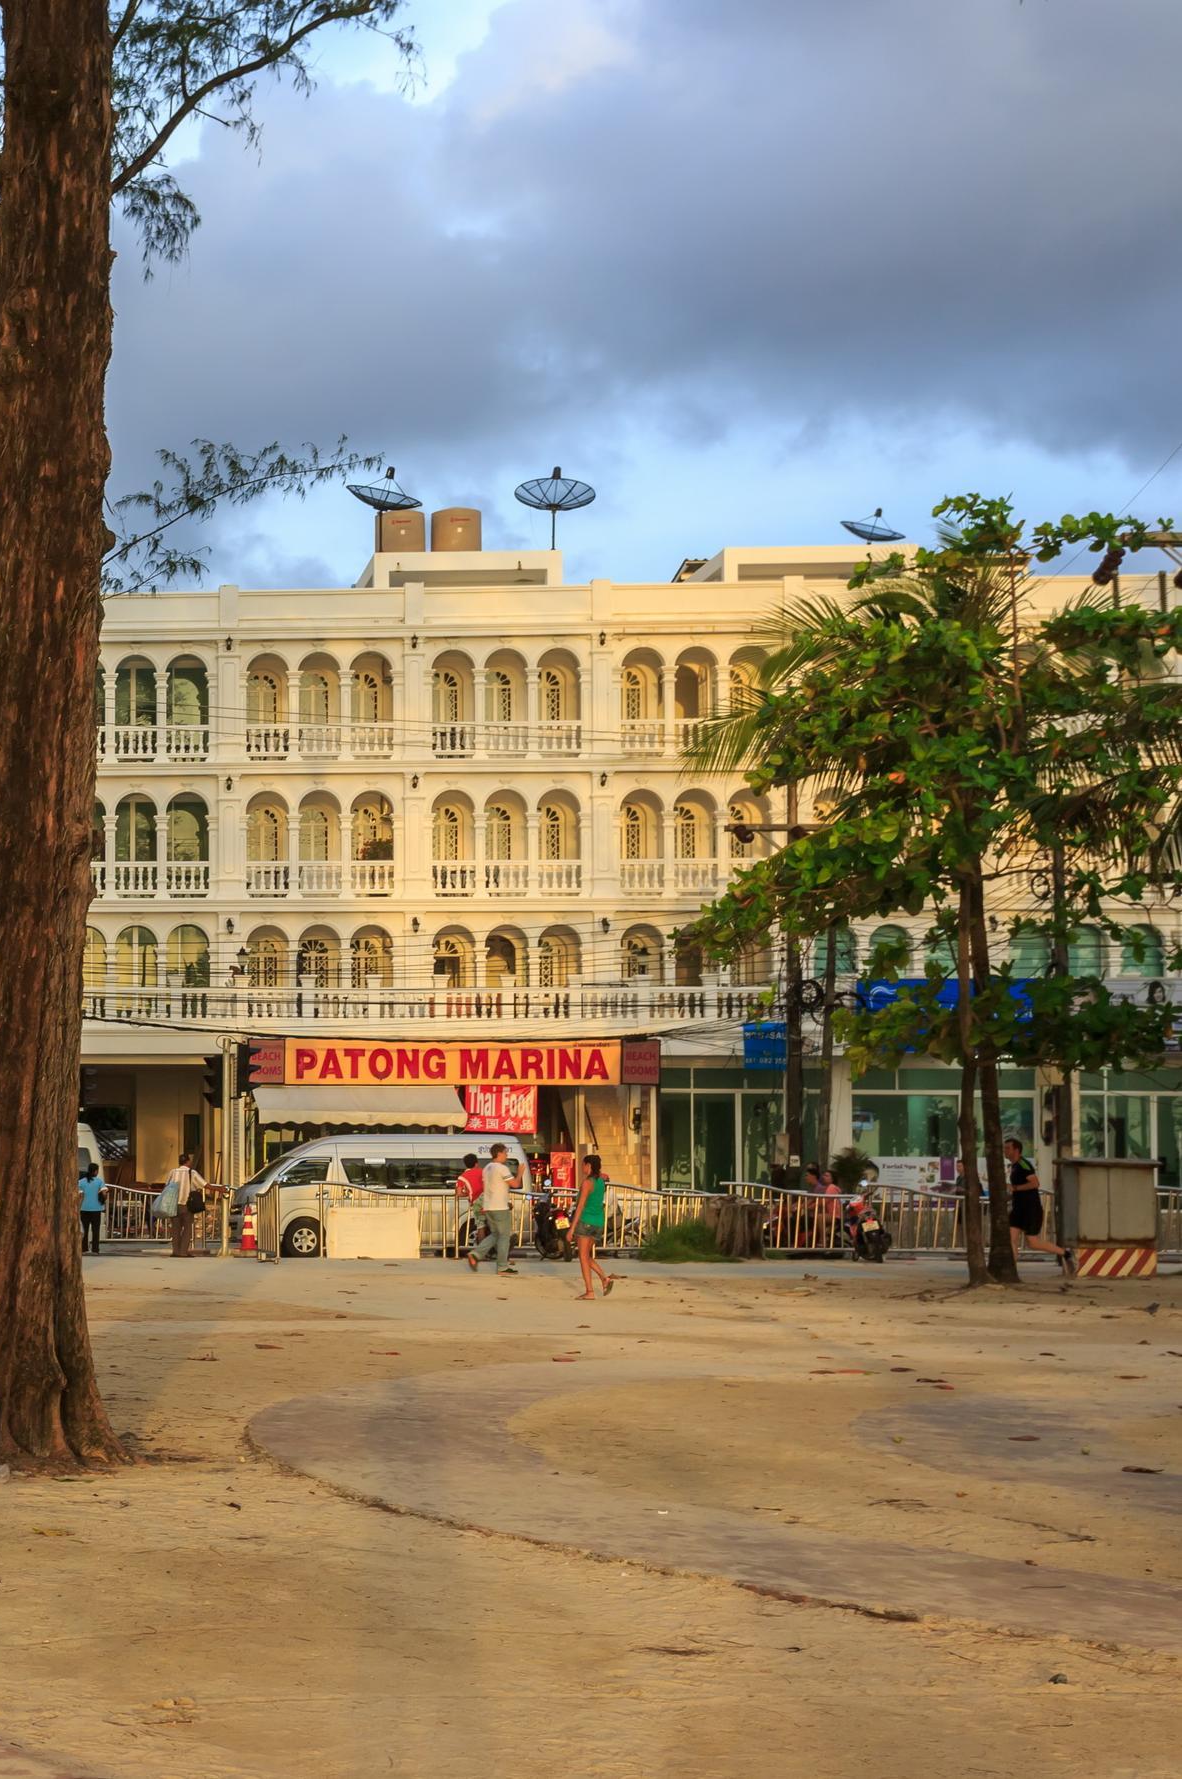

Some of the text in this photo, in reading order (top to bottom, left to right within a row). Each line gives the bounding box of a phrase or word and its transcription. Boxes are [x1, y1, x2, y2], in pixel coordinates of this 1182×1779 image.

[626, 1052, 657, 1060] BEACH
[296, 1048, 609, 1080] PATONG MARINA
[624, 1066, 658, 1075] ROOMS
[469, 1085, 533, 1118] Thai Food
[468, 1117, 533, 1130] 泰国食品
